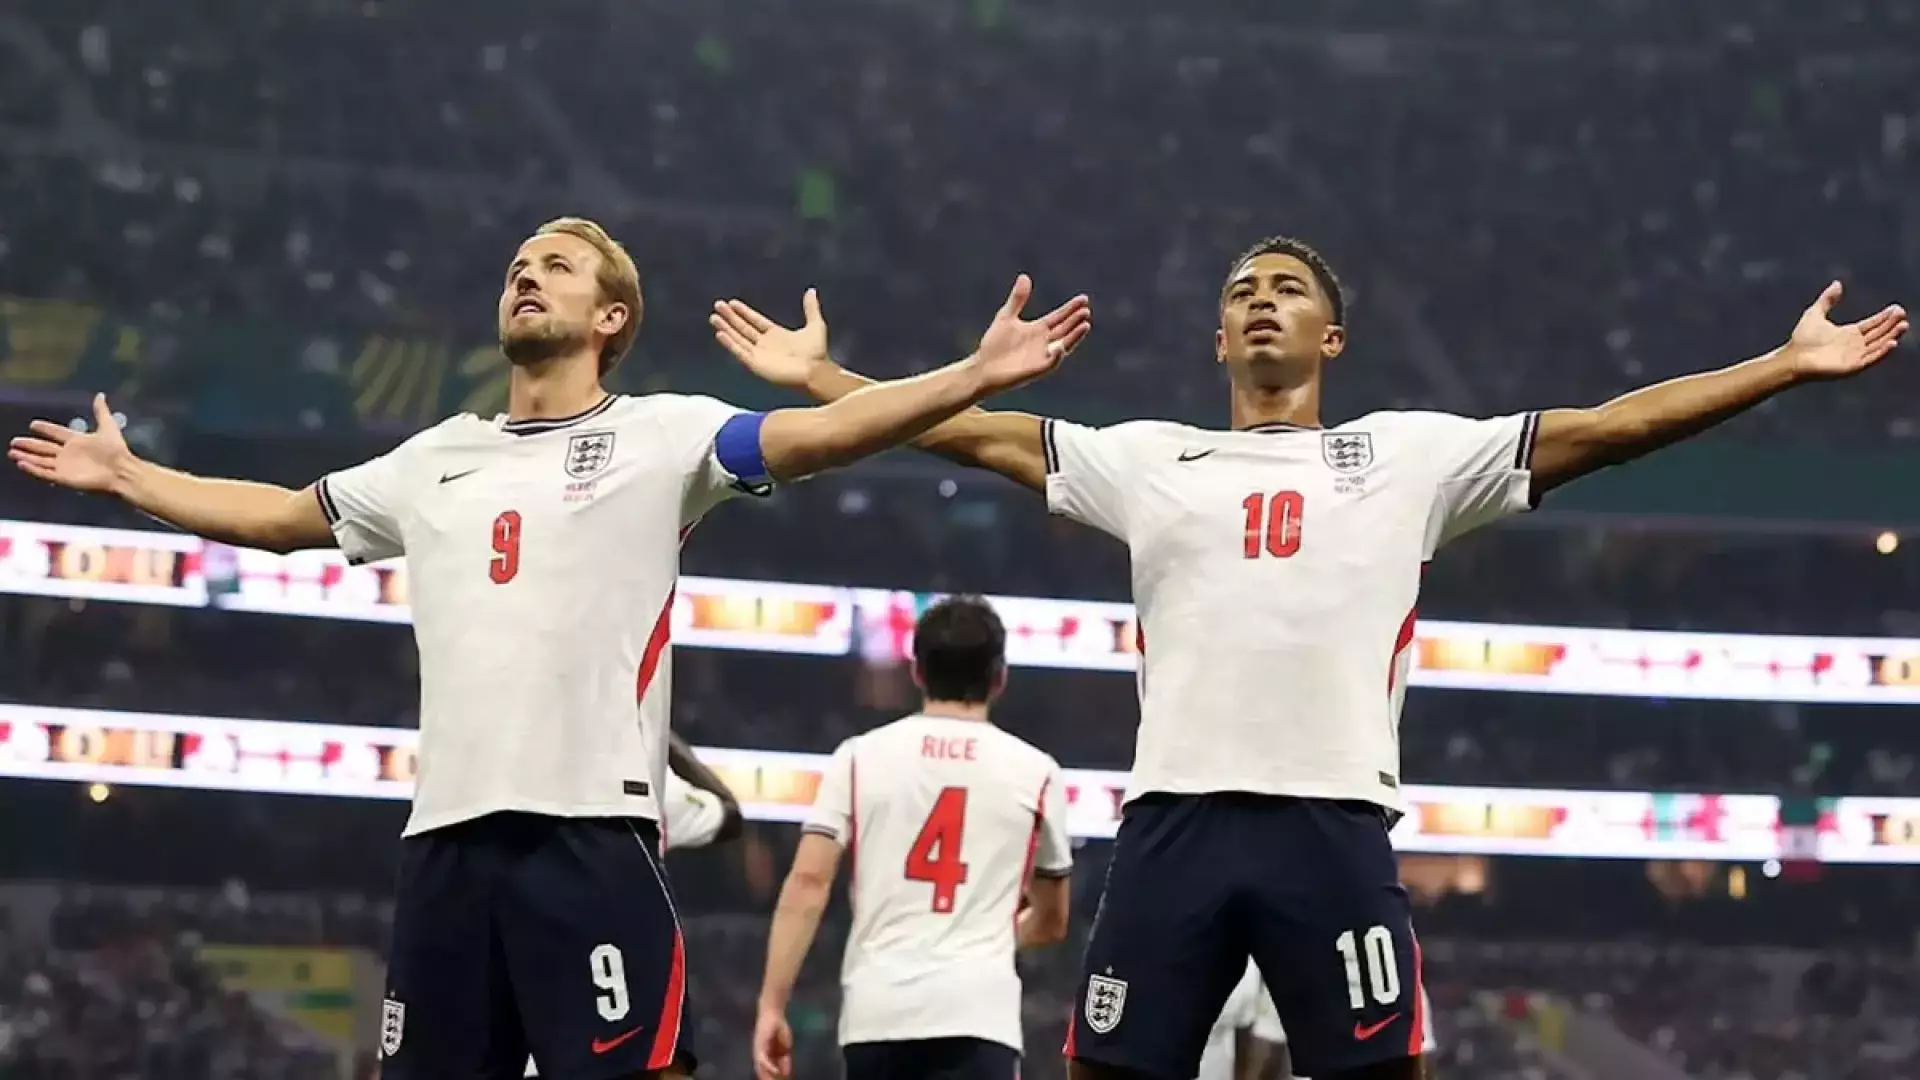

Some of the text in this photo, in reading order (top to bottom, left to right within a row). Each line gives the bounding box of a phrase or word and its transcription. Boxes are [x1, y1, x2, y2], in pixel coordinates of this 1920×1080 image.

[488, 509, 522, 584] 9
[1242, 490, 1304, 559] 10
[921, 734, 979, 761] RICE
[904, 786, 968, 912] 4
[589, 943, 630, 1022] 9
[1335, 924, 1400, 1009] 10
